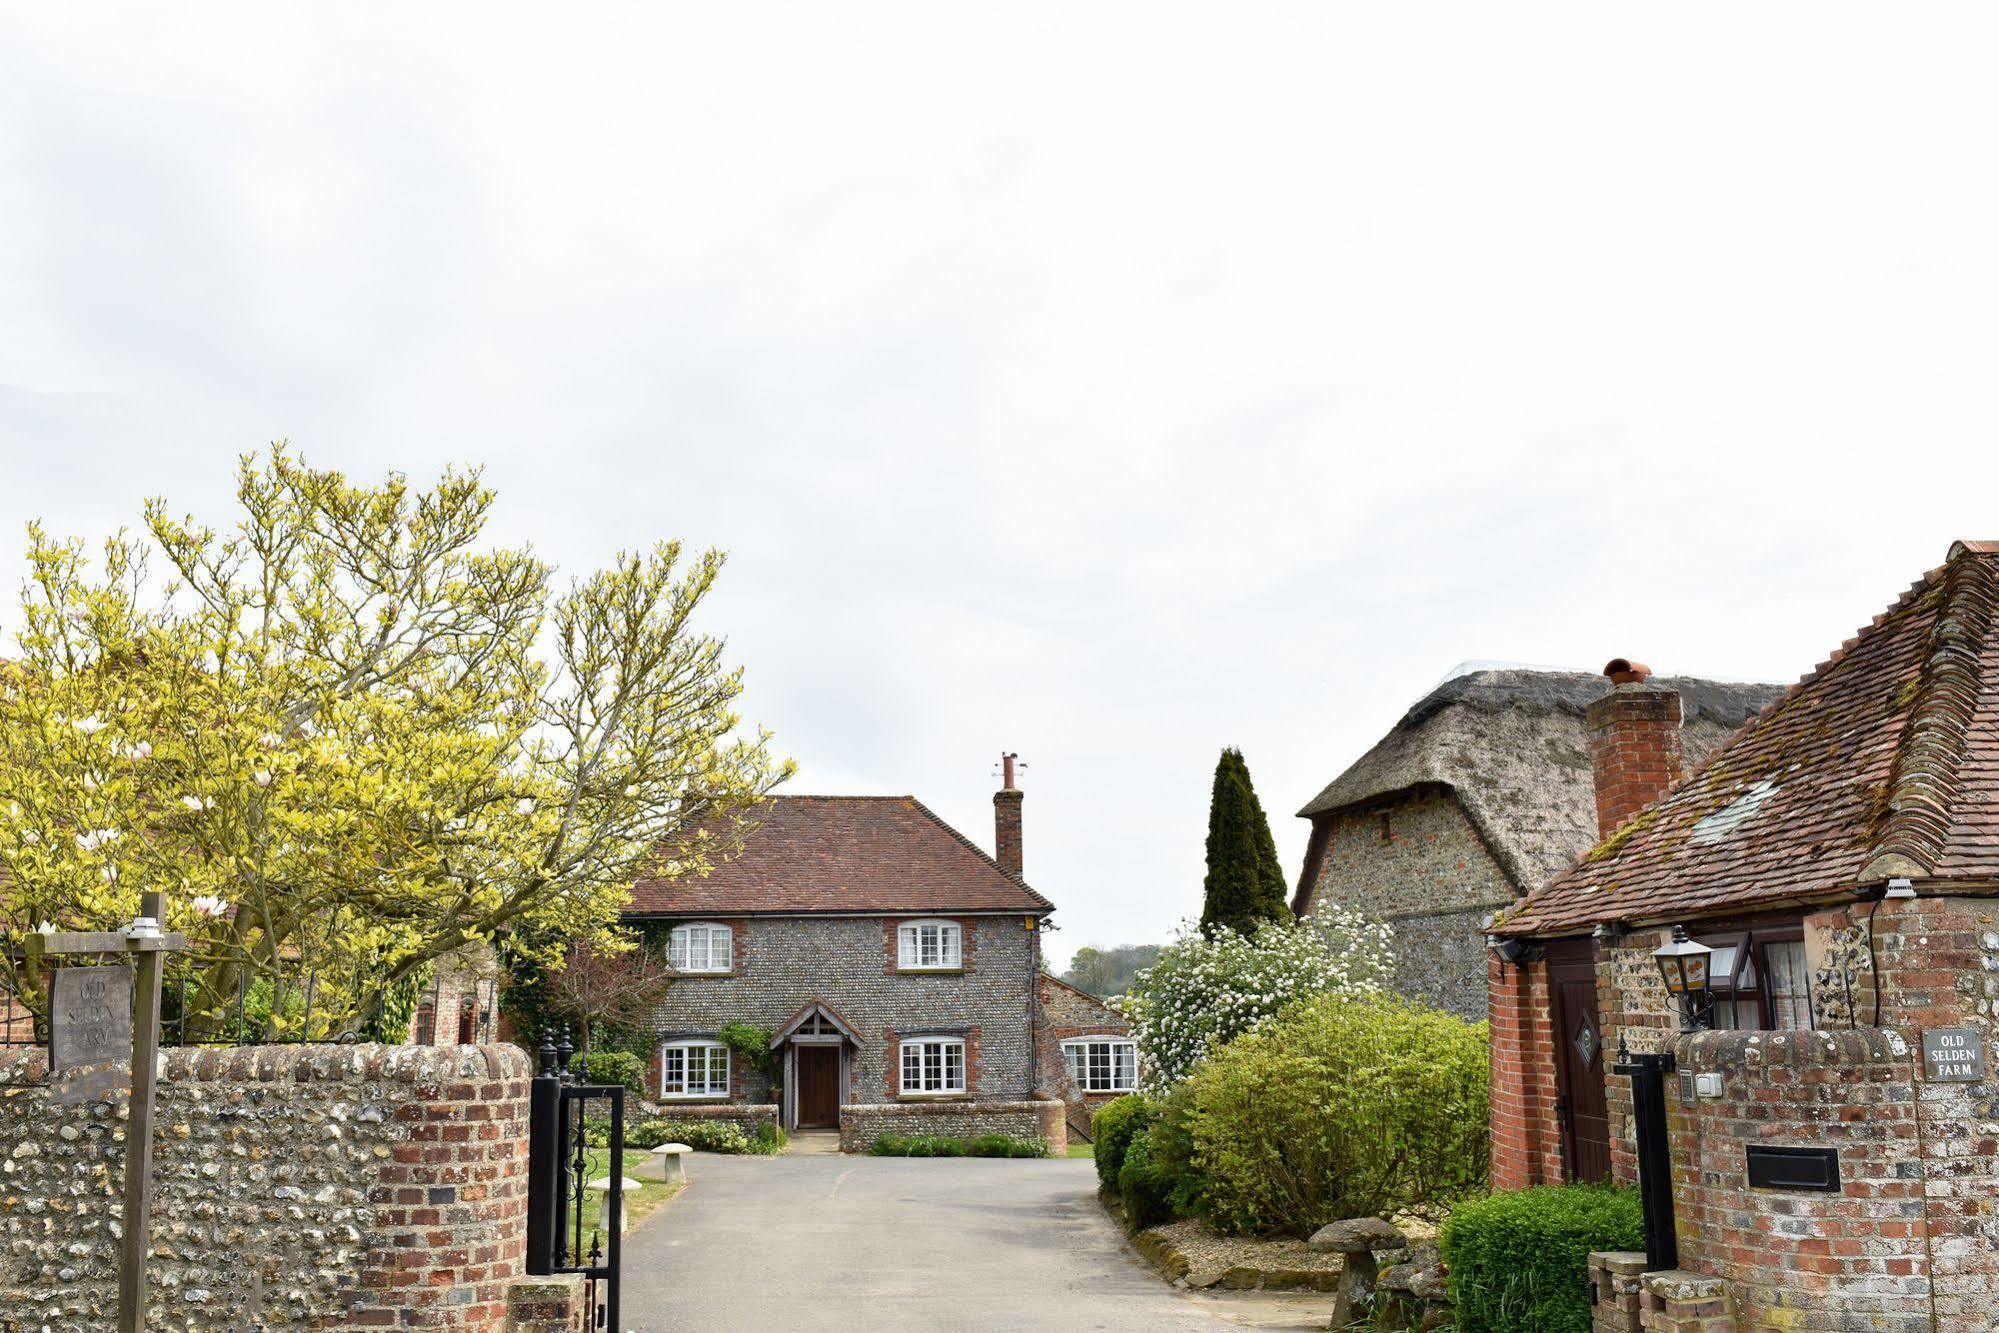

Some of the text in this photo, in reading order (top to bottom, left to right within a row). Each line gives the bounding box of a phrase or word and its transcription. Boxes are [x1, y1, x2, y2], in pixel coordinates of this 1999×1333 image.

[77, 1026, 111, 1046] ARM
[1941, 1035, 1964, 1047] OLD
[1932, 1049, 1976, 1062] SELDEN
[1938, 1064, 1972, 1076] FARM
